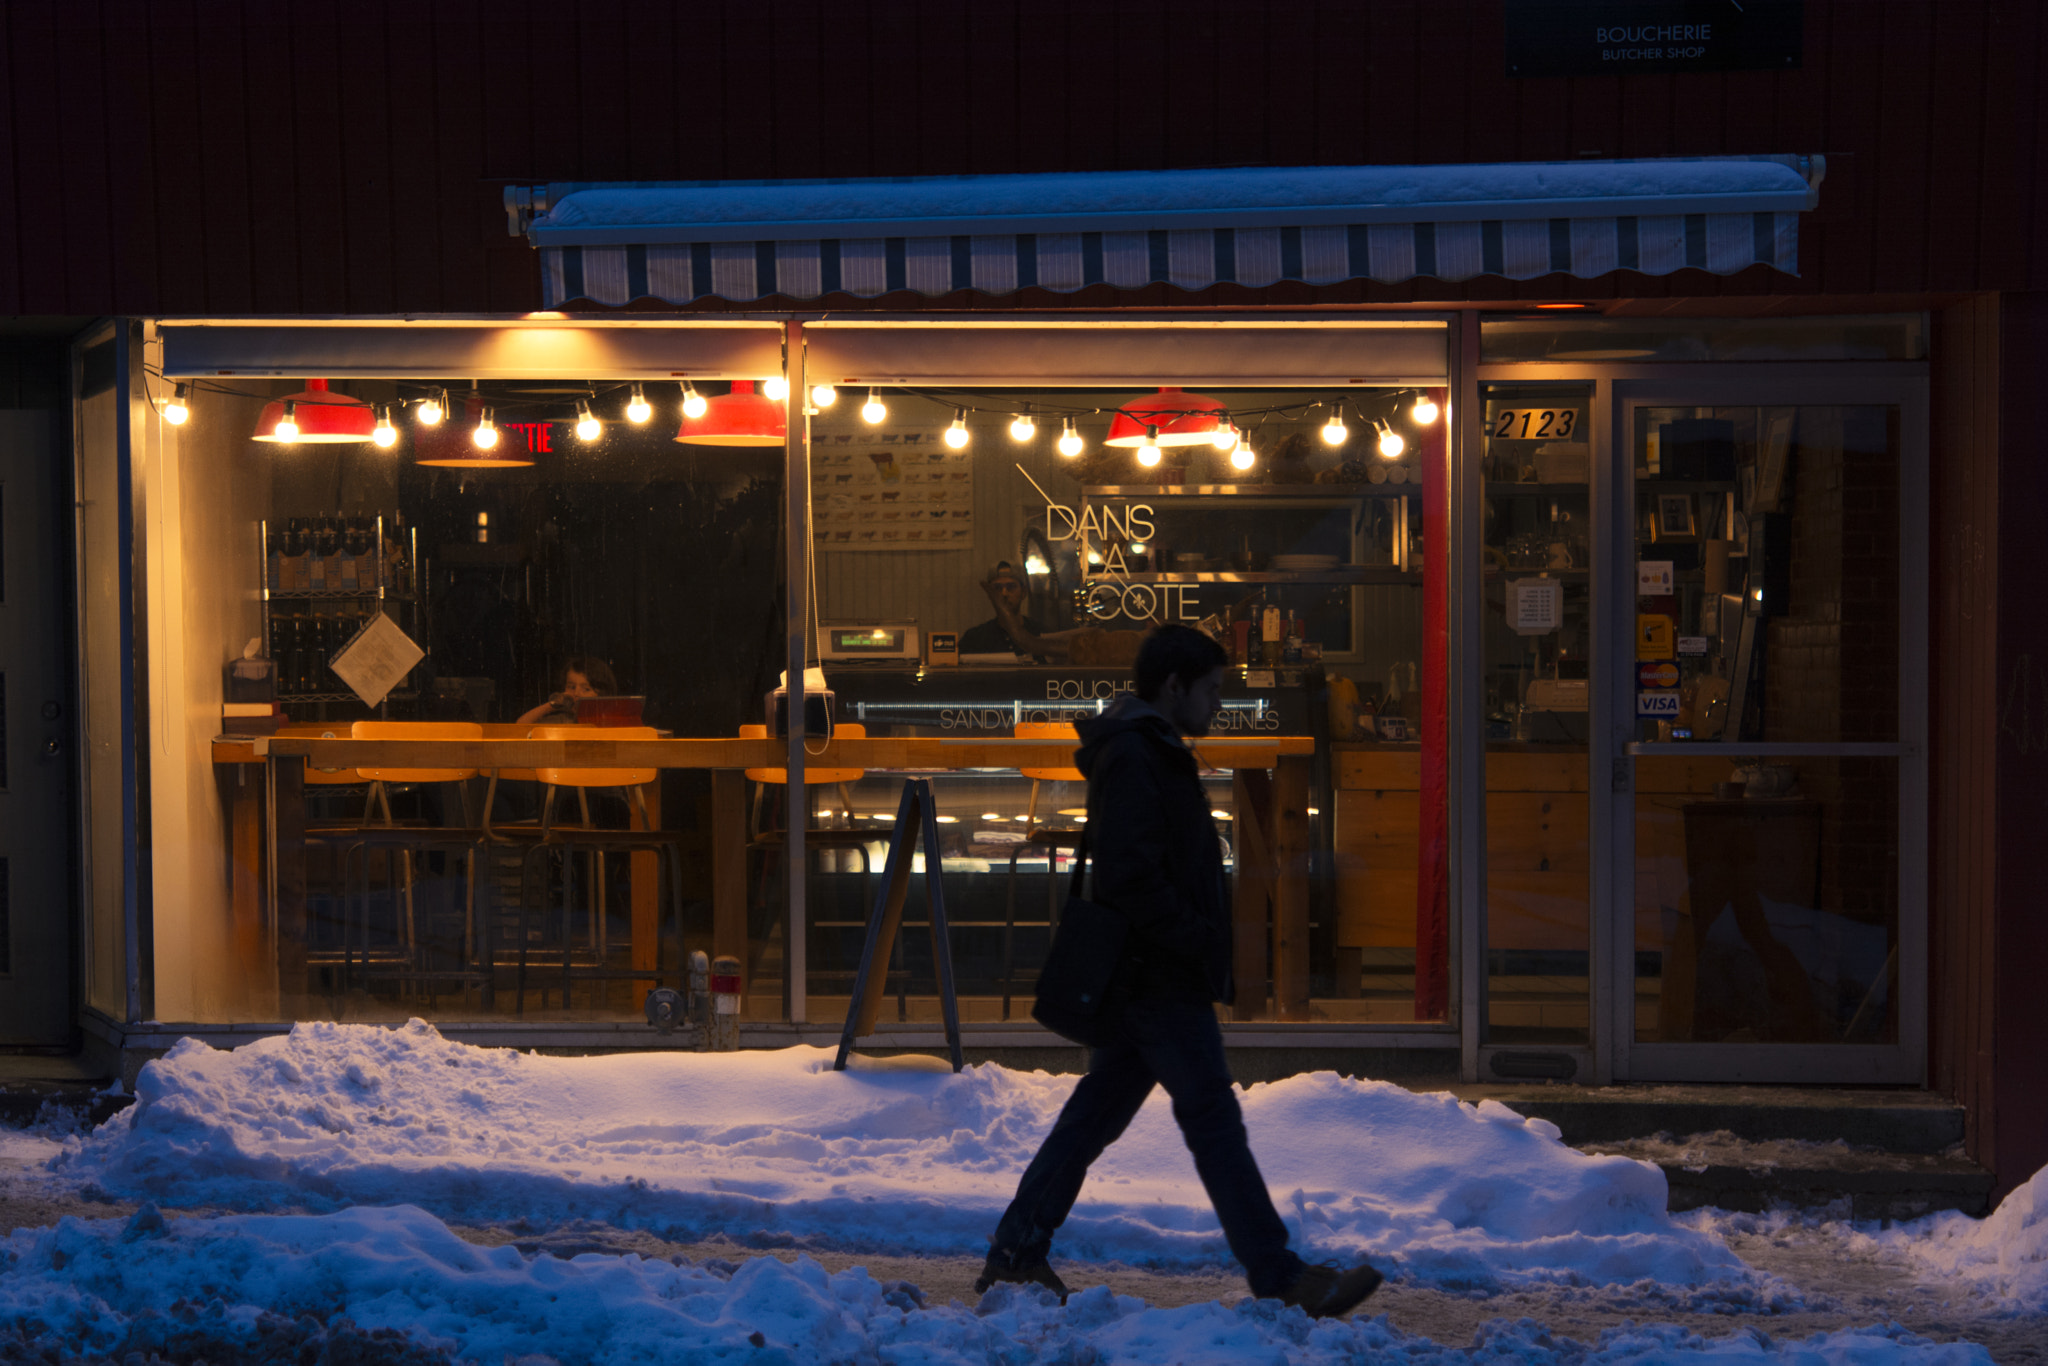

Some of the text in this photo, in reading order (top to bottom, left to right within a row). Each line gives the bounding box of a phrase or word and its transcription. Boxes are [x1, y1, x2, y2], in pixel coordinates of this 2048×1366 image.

[1596, 24, 1712, 44] BOUCHERIE
[1601, 45, 1706, 61] BUTCHER SHOP
[1496, 410, 1574, 438] 2123
[1046, 504, 1155, 541] DANS
[1082, 542, 1131, 579] LA
[1088, 583, 1200, 620] COTE
[1642, 697, 1677, 710] VISA
